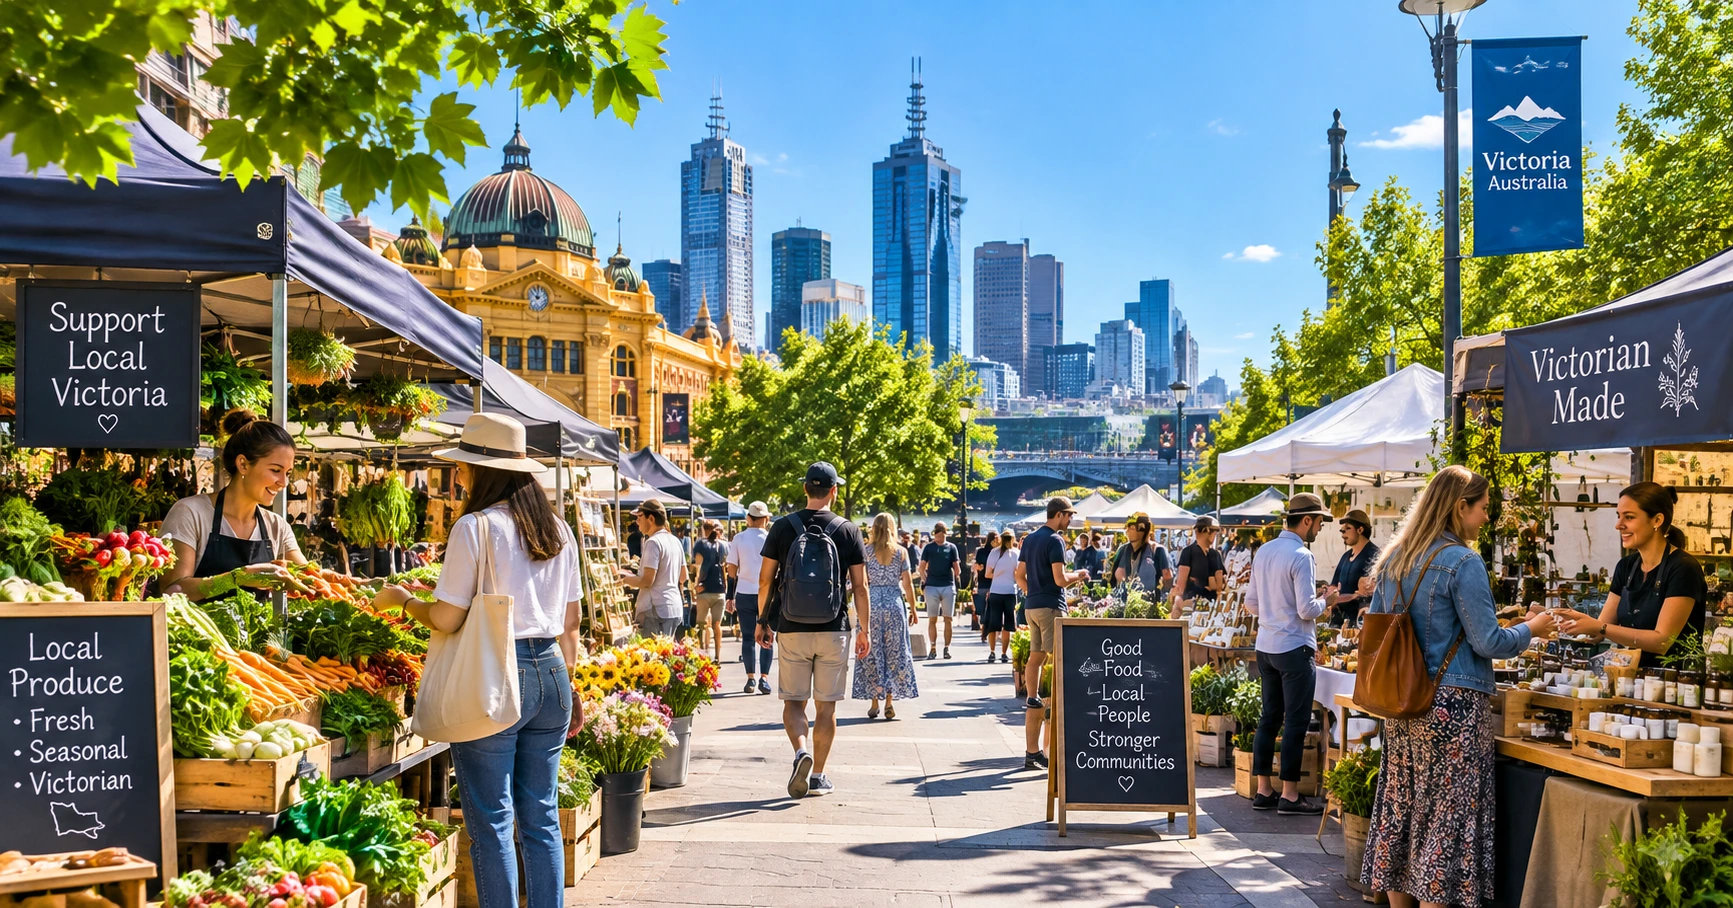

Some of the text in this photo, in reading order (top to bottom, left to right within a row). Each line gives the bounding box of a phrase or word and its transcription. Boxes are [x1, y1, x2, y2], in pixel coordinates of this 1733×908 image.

[1482, 150, 1571, 171] Victoria
[1488, 172, 1567, 191] Australia
[49, 301, 165, 343] Support
[68, 340, 146, 371] Local
[1530, 334, 1651, 383] Victorian
[51, 376, 168, 407] Victoria
[1551, 382, 1625, 425] Made
[29, 631, 102, 662] Local
[1101, 638, 1142, 657] Good
[1103, 659, 1142, 677] Food
[8, 666, 123, 698] Produce
[1101, 683, 1144, 701] Local
[30, 706, 94, 733] Fresh
[1097, 704, 1150, 729] People
[29, 735, 128, 764] Seasonal
[1088, 729, 1160, 752] Stronger
[1075, 751, 1174, 770] Communities
[29, 769, 132, 796] Victorian
